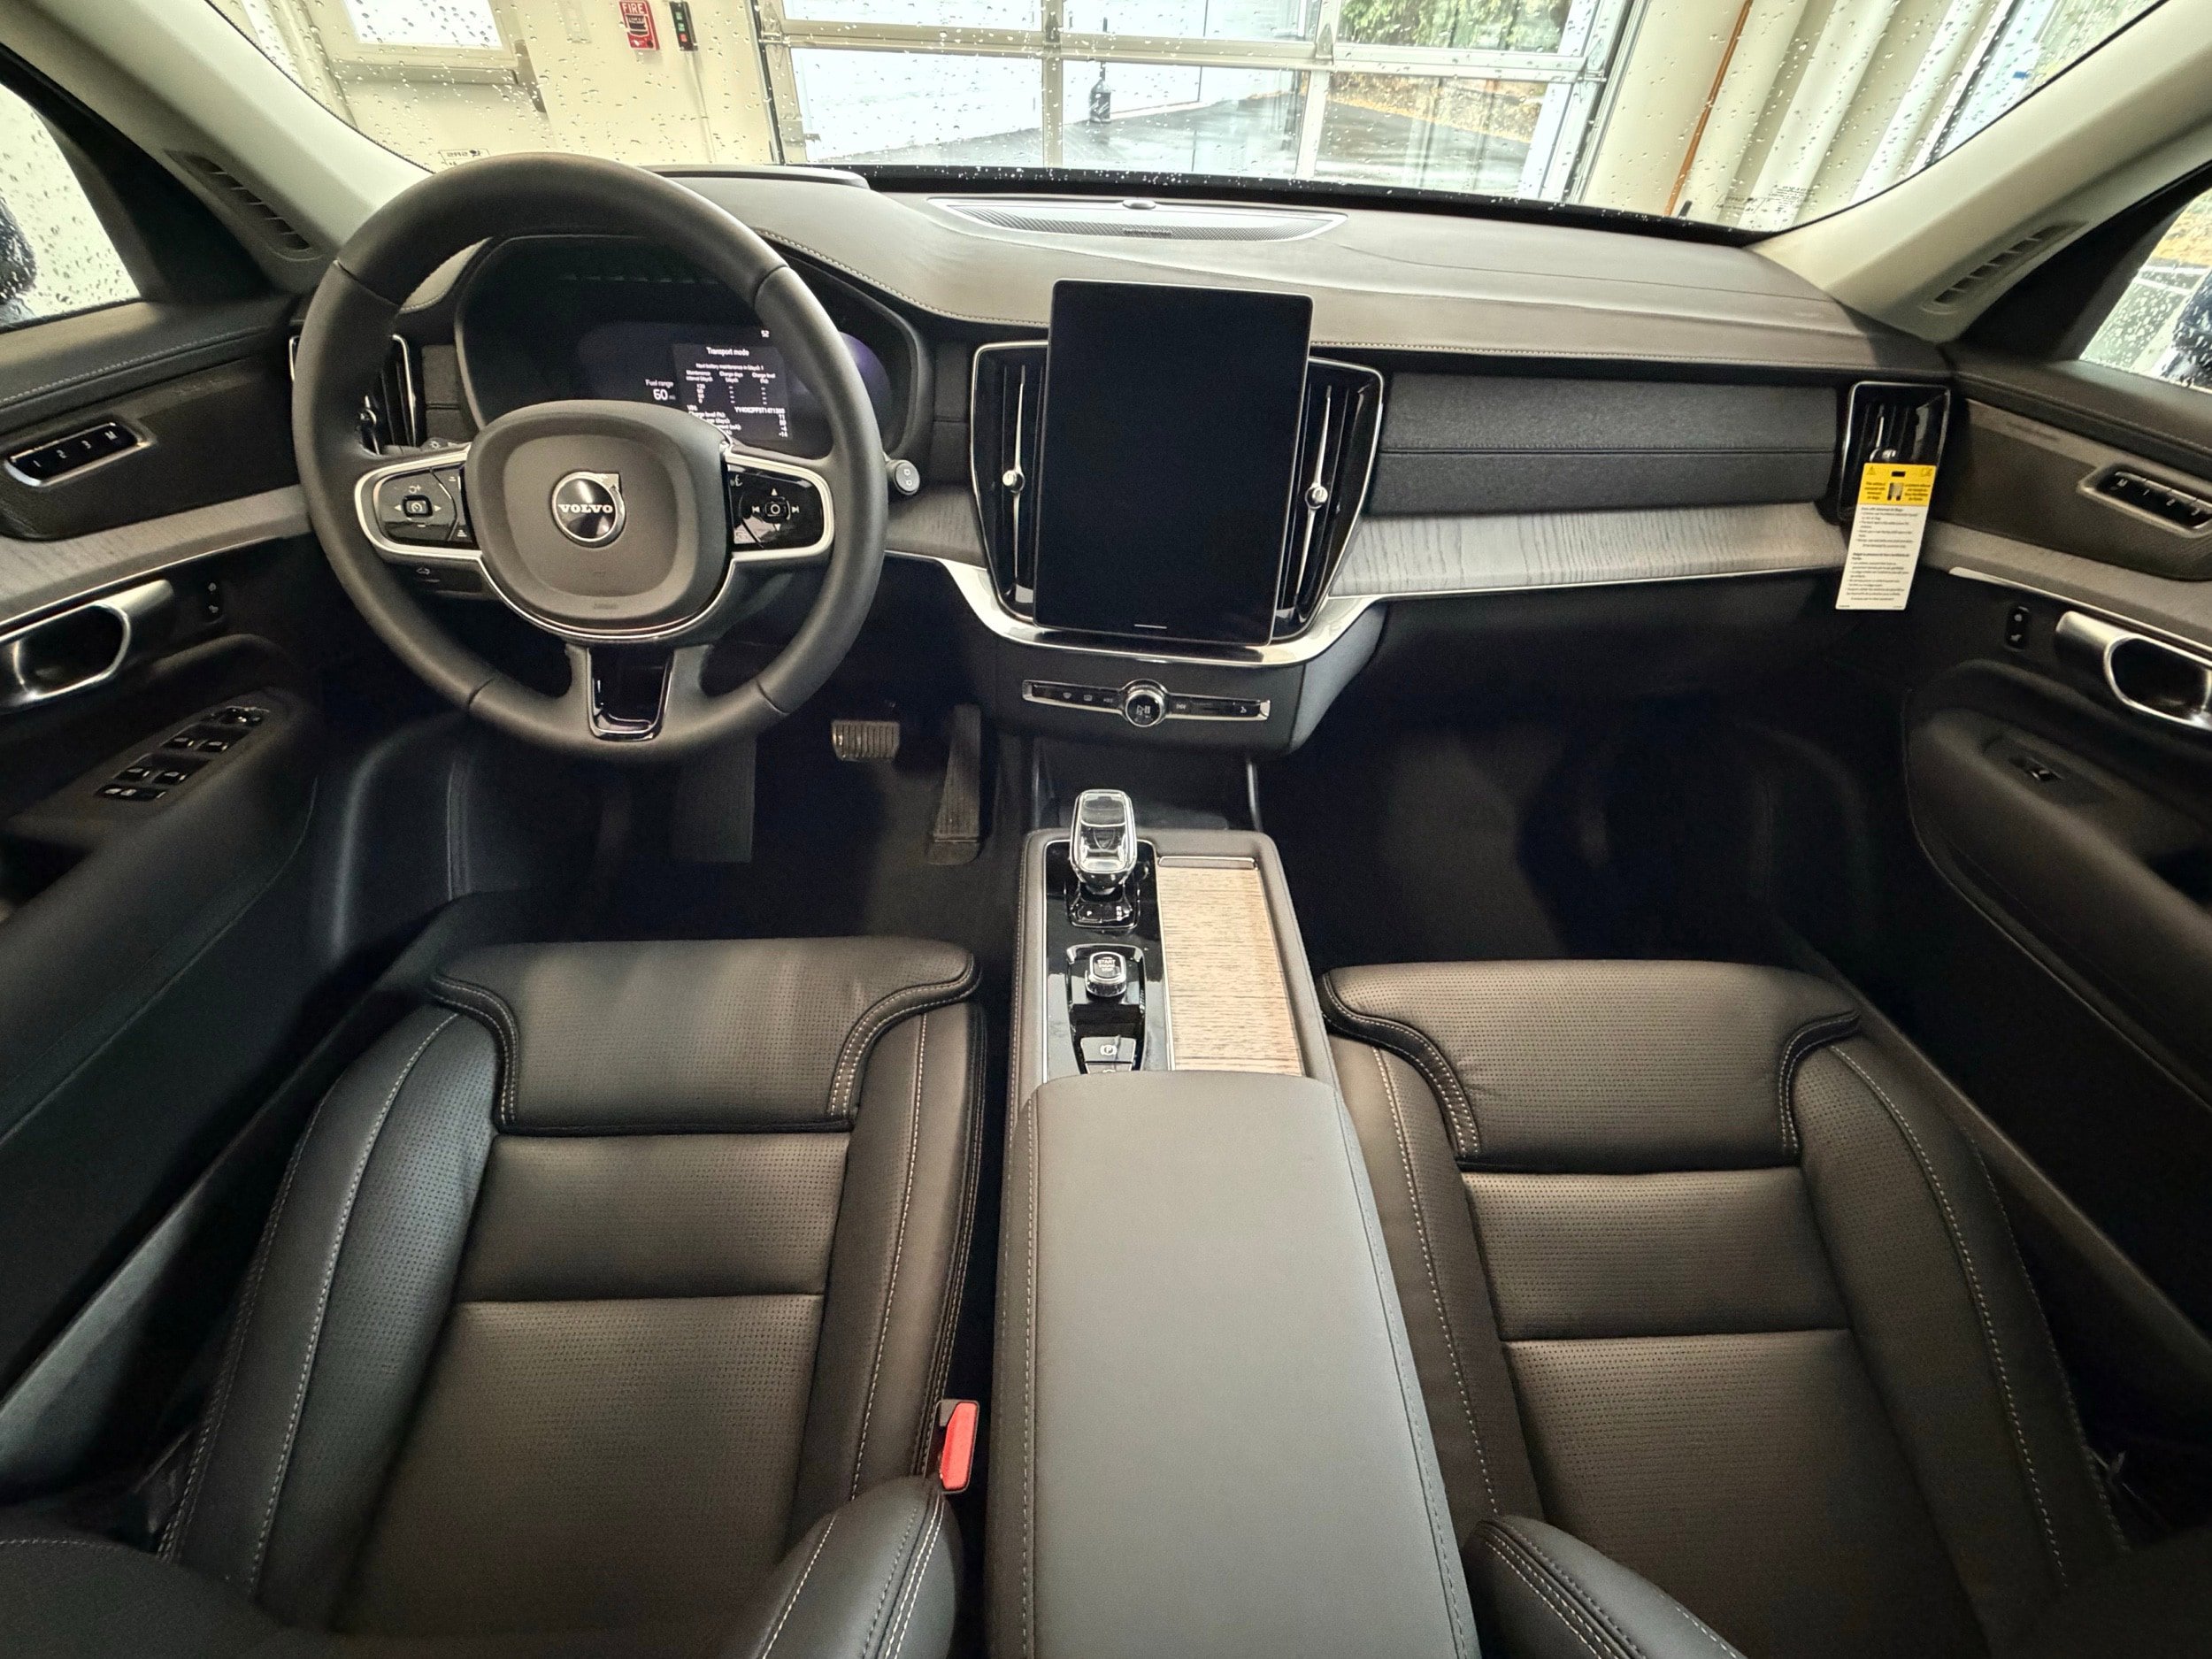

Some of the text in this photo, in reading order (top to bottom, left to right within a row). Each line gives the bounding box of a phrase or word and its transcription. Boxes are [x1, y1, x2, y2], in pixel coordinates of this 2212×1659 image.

[622, 3, 645, 14] FIRE
[706, 347, 733, 357] Transport
[653, 388, 668, 401] 60
[104, 430, 119, 441] M
[557, 503, 614, 513] VOLVO
